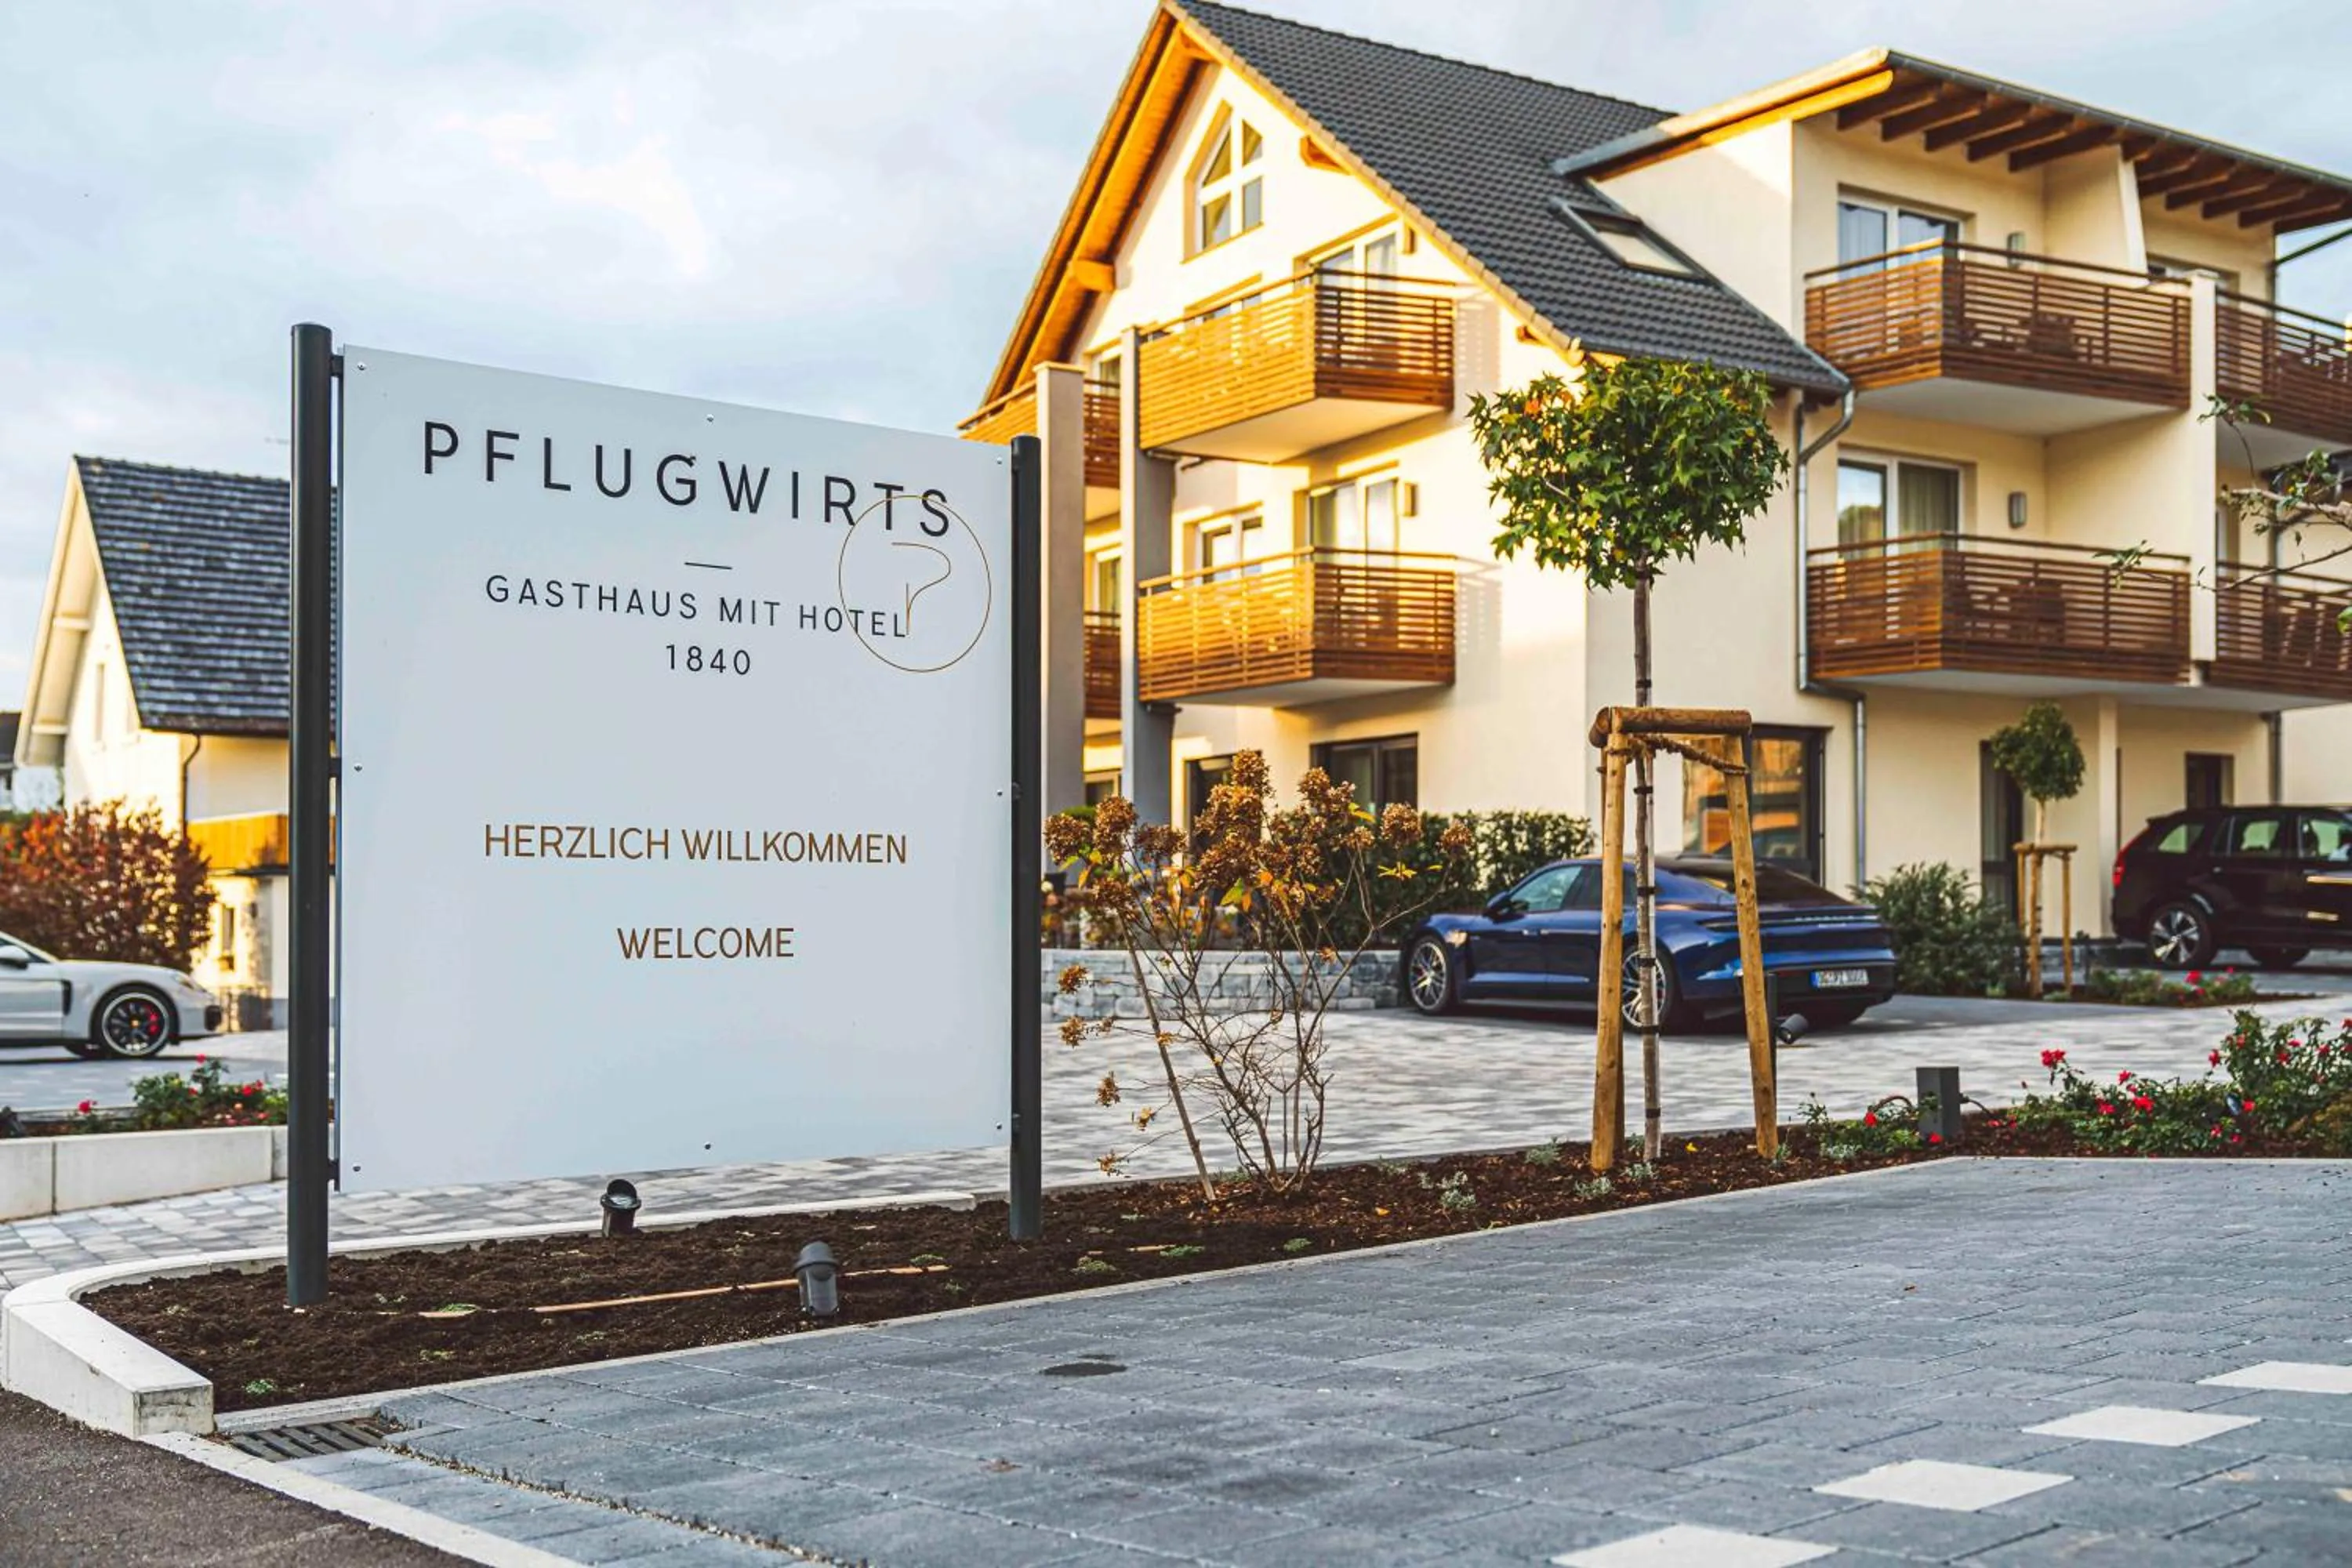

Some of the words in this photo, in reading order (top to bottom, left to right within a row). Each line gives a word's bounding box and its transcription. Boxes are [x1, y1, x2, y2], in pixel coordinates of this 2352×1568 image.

[423, 419, 950, 539] PFLUGWIRTS
[485, 574, 698, 621] GASTHAUS
[719, 596, 782, 627] MIT
[798, 604, 907, 639] HOTEL
[665, 643, 752, 677] 1840
[485, 823, 670, 861] HERZLICH
[681, 828, 907, 865] WILLKOMMEN
[616, 926, 795, 960] WELCOME
